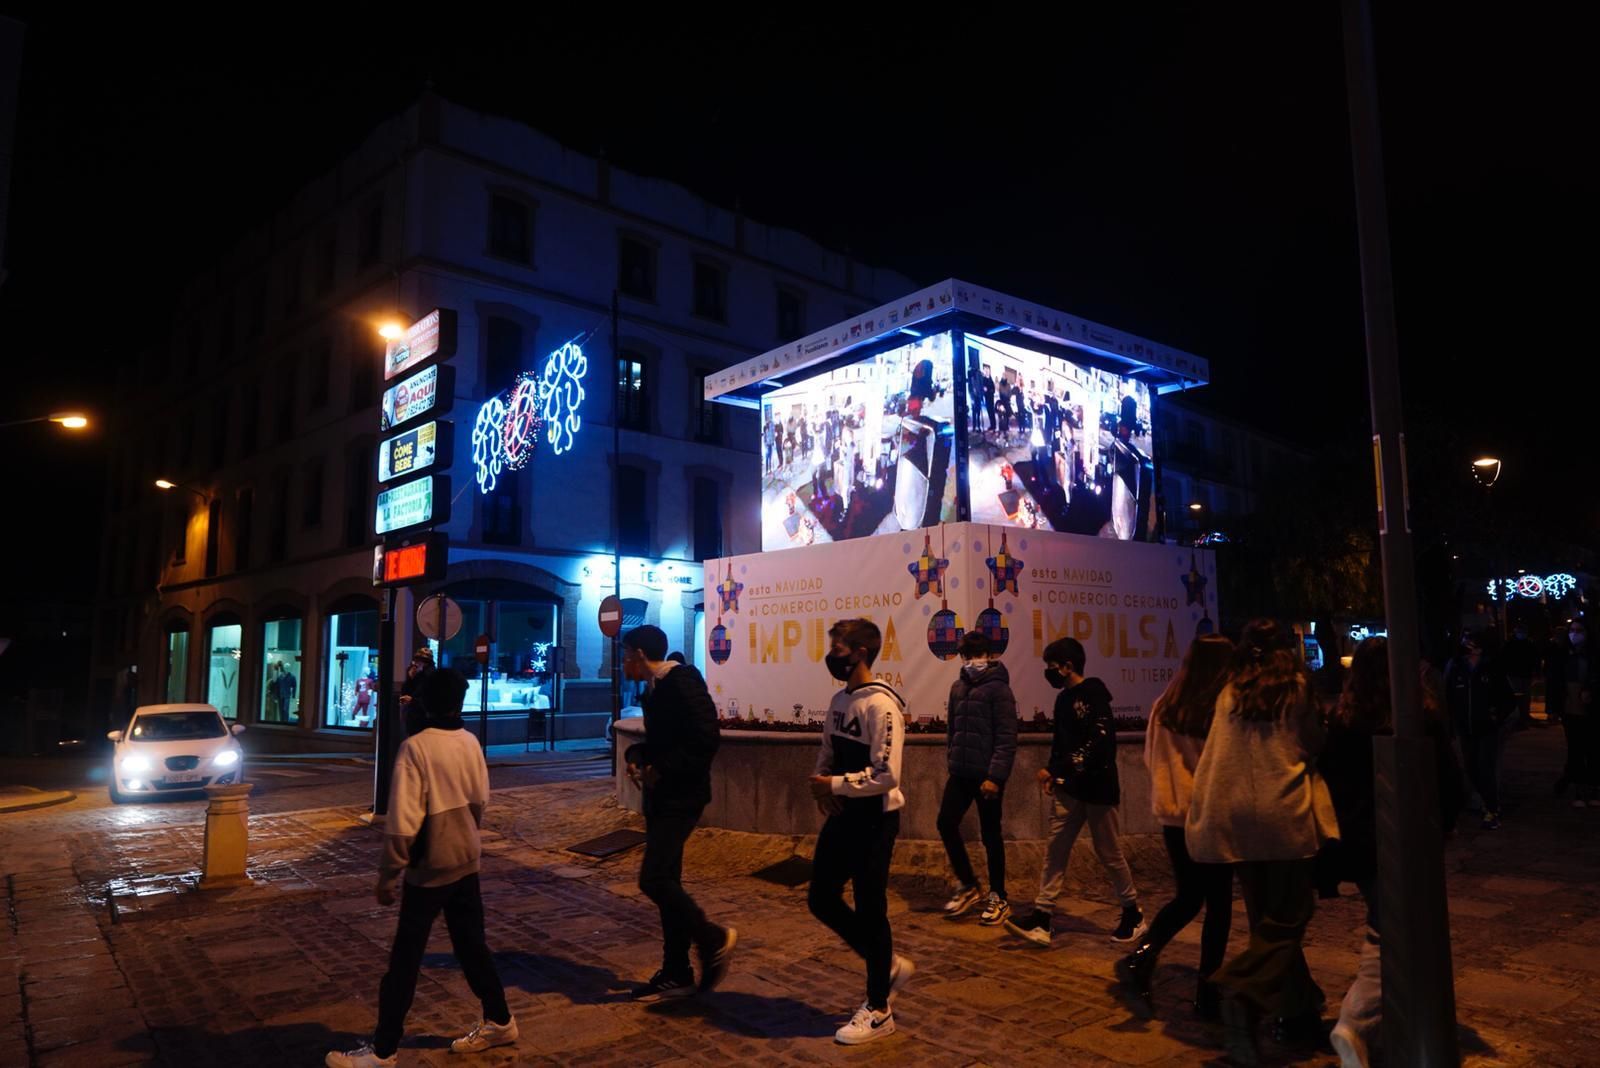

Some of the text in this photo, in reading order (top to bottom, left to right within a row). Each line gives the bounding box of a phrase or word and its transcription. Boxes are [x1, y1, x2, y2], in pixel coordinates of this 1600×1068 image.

[393, 442, 413, 460] COME
[394, 456, 412, 473] BEBE
[1031, 567, 1113, 584] esta NAVIDAD
[749, 577, 823, 596] esta NAVIDAD
[749, 592, 903, 617] el COMERCIO CERCANO
[1032, 590, 1179, 610] el COMERCIO CERCANO
[748, 615, 904, 664] IMPUA
[1032, 609, 1181, 659] IMPULSA
[1121, 667, 1173, 683] TU TIERR
[832, 711, 862, 738] FILA
